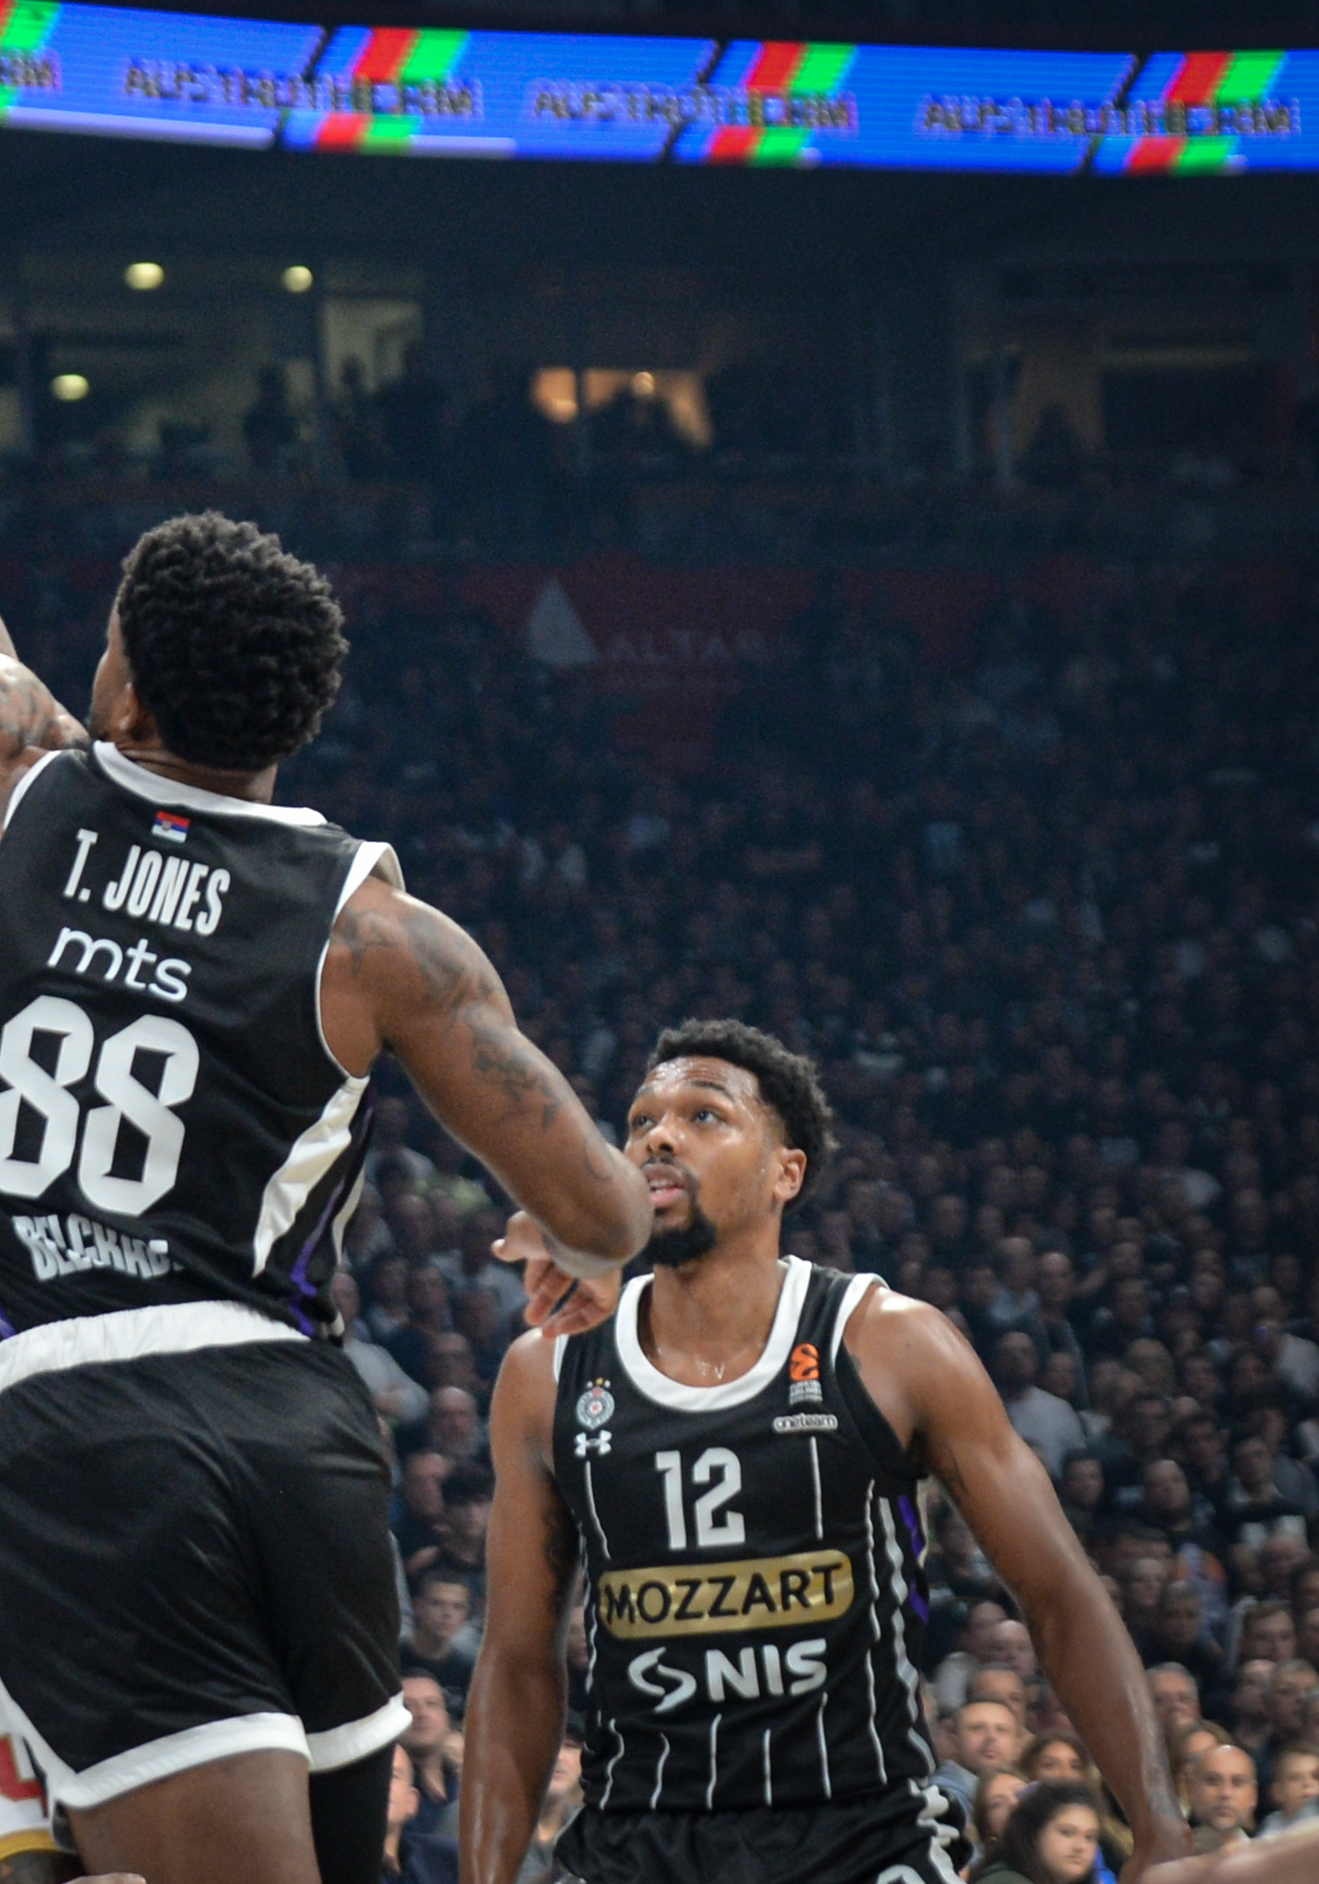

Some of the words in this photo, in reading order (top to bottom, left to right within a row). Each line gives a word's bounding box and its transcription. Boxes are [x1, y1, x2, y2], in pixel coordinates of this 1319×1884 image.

[64, 828, 98, 902] T.
[102, 844, 232, 936] JONES
[46, 926, 193, 1001] mts
[655, 1447, 746, 1550] 12
[604, 1561, 844, 1625] MOZZART
[705, 1637, 828, 1702] NIS
